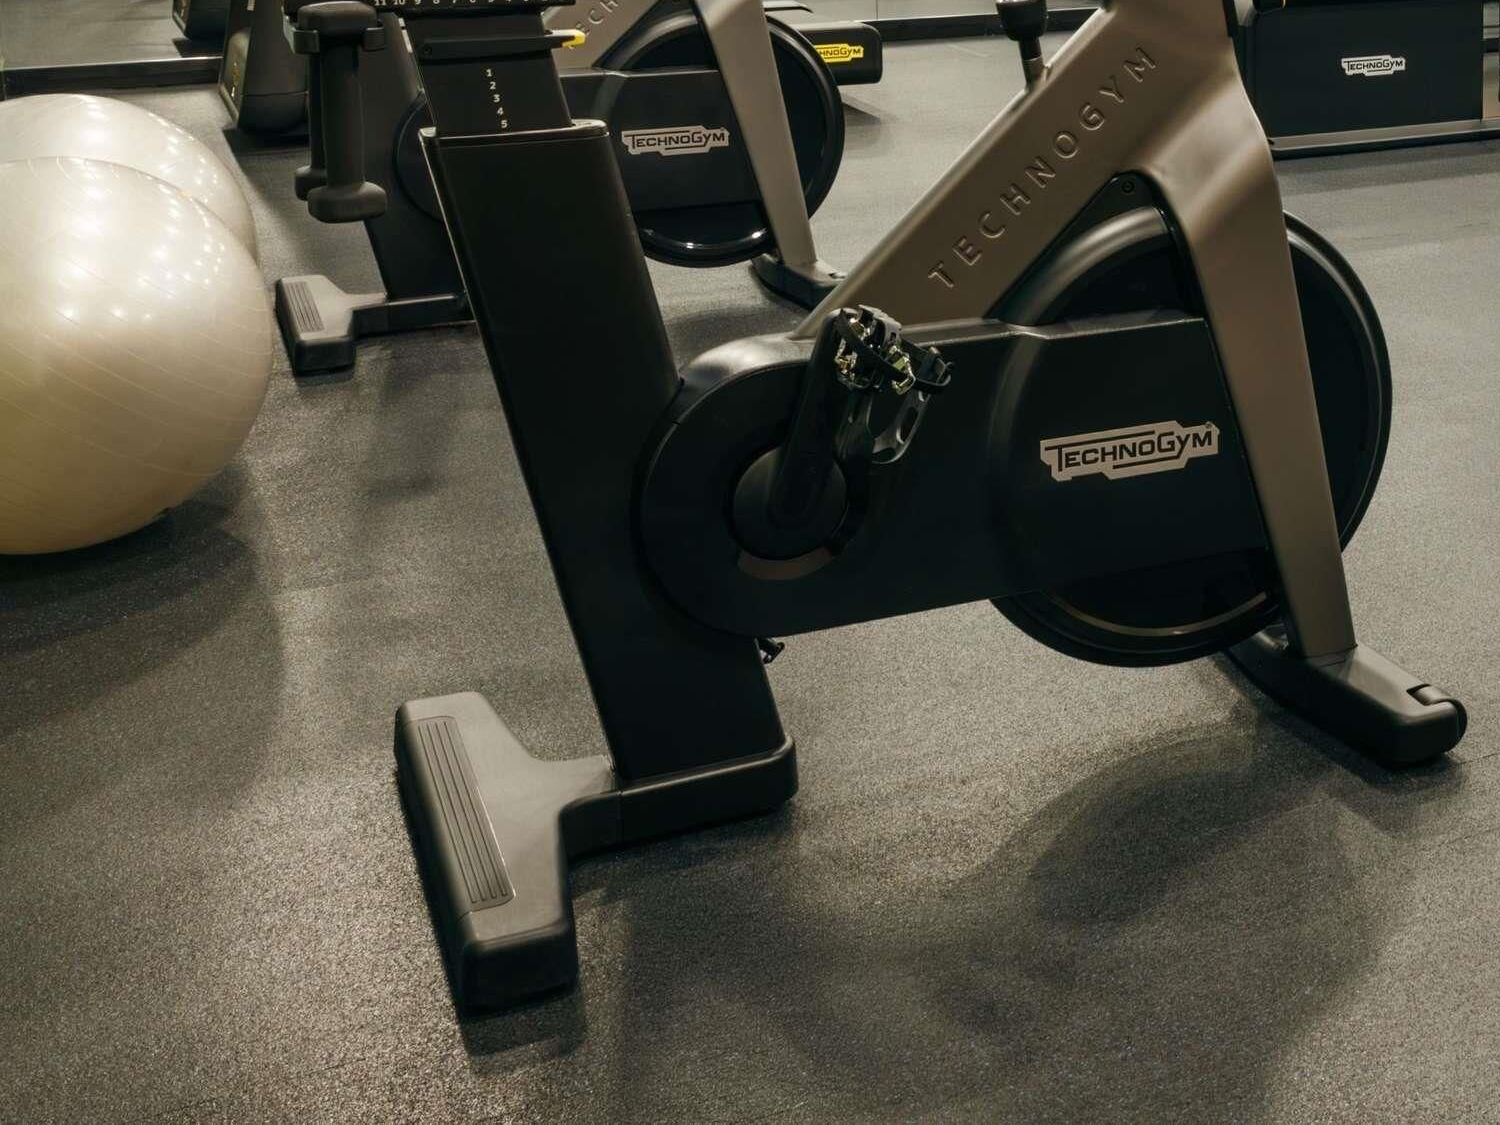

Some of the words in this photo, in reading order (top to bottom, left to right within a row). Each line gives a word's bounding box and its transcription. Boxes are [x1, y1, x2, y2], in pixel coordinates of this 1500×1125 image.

[816, 45, 862, 60] HNOGYM
[1343, 57, 1404, 73] TECHNOGYM
[486, 68, 492, 77] 1
[490, 81, 496, 90] 2
[493, 94, 500, 103] 3
[497, 107, 504, 115] 4
[501, 119, 508, 128] 5
[623, 130, 726, 151] TECHNOGYM
[928, 46, 1156, 288] TECHNOGYM
[1044, 429, 1213, 473] TECHNOGYM
